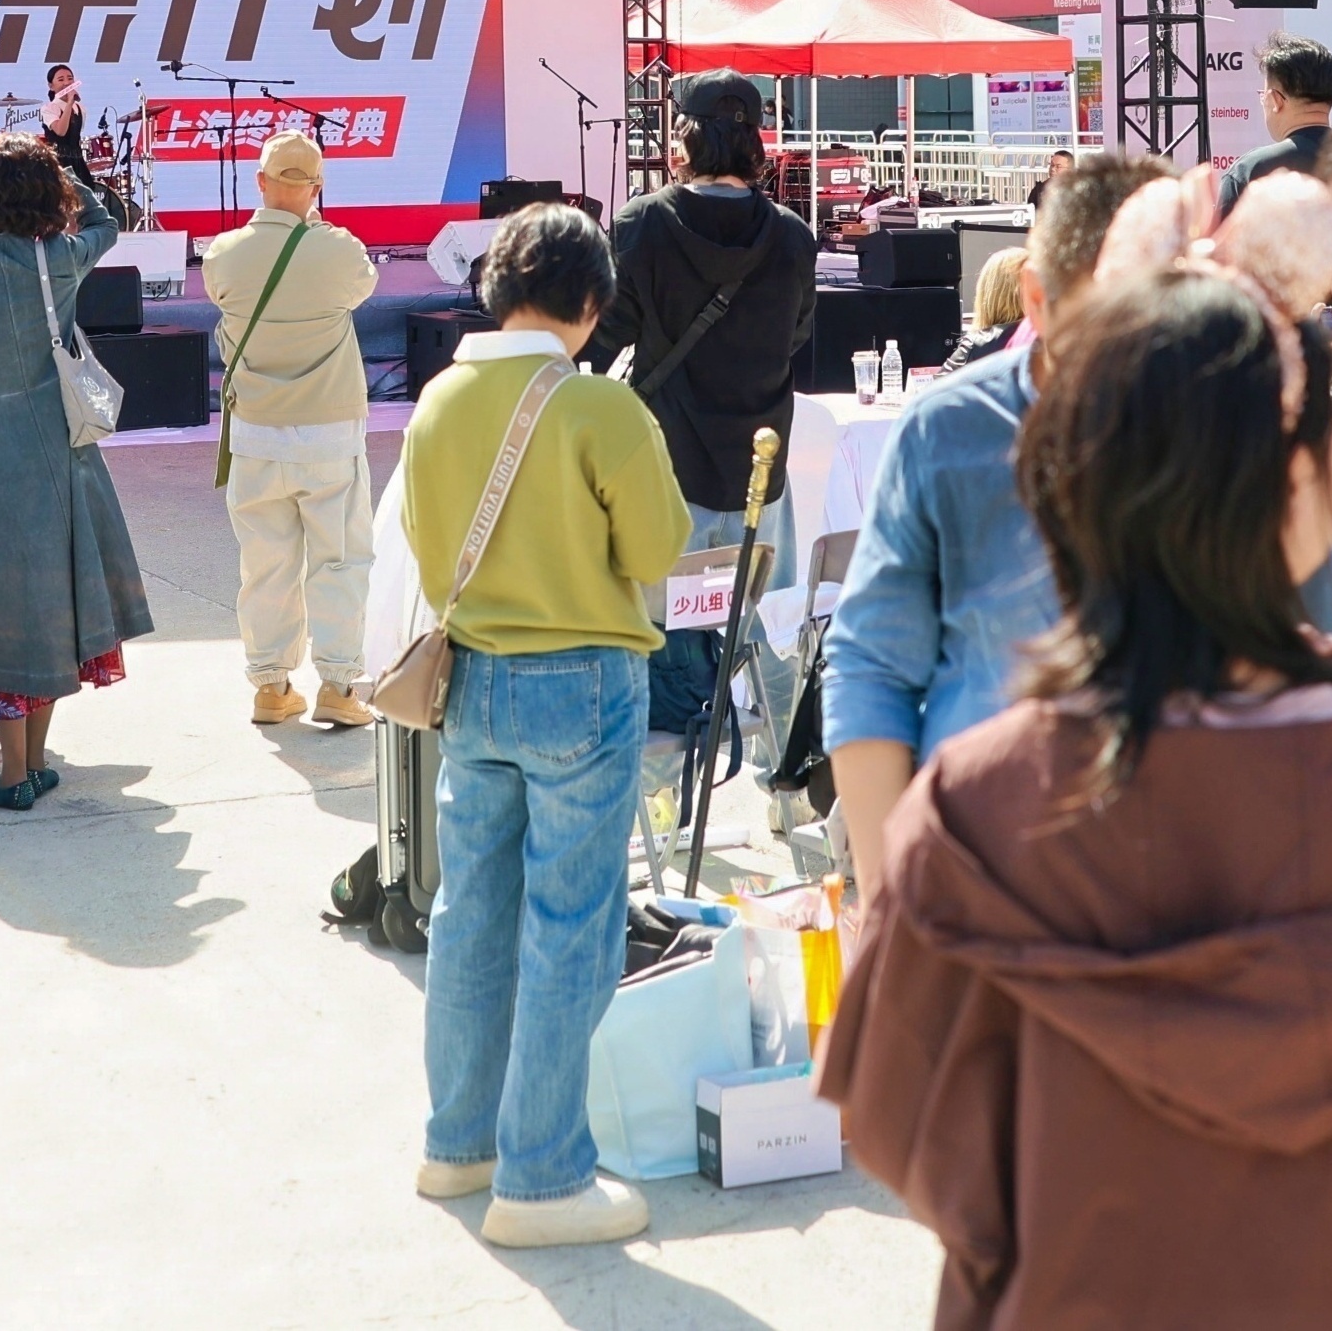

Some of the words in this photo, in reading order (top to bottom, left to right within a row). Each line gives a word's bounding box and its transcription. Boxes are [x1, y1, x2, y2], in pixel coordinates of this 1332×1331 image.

[1206, 52, 1244, 71] AKG
[1211, 107, 1249, 120] steinberg
[467, 492, 500, 555] VUITTON
[757, 1134, 807, 1150] PARZIN
